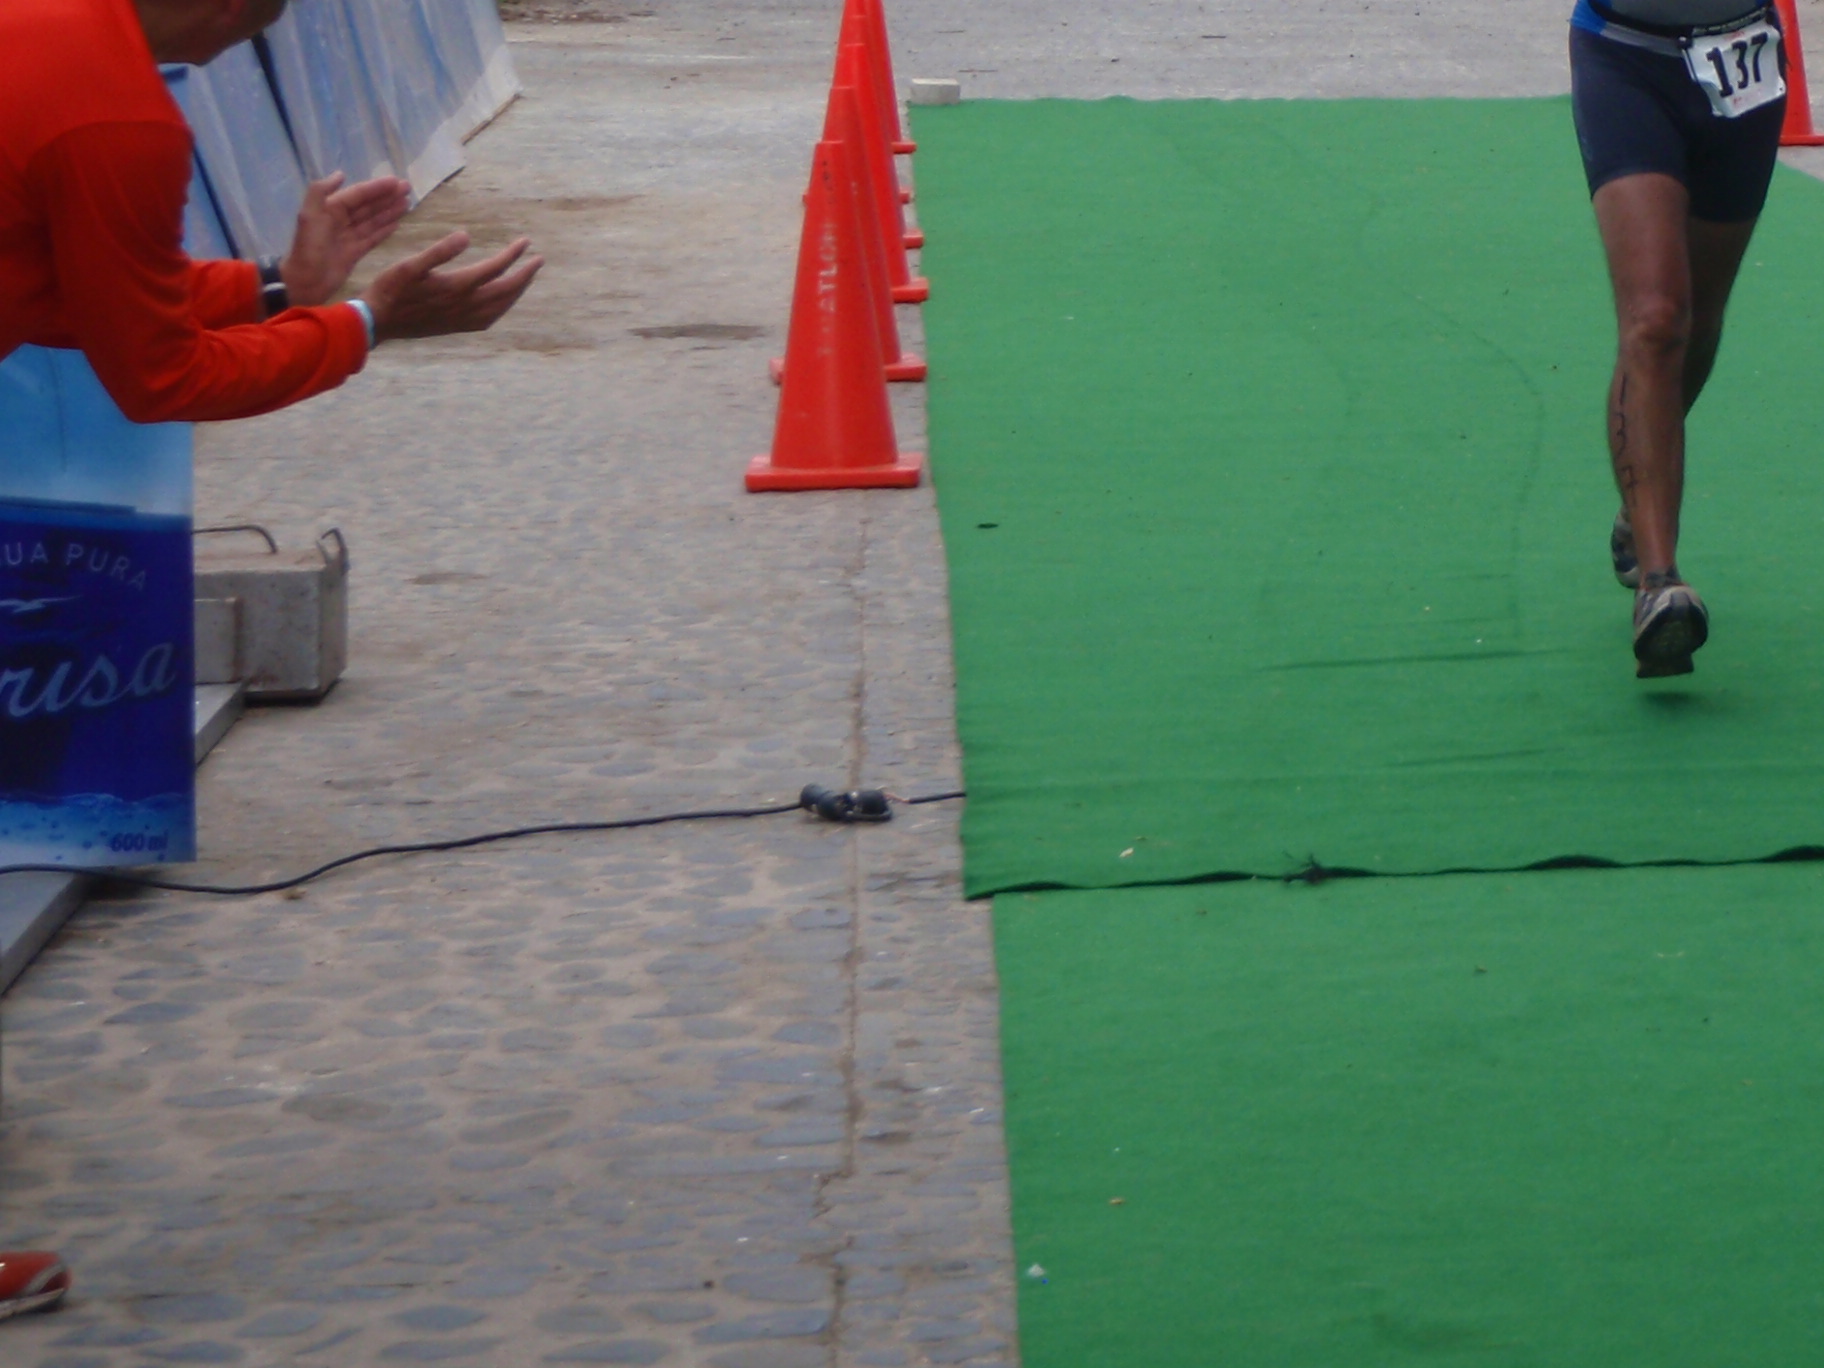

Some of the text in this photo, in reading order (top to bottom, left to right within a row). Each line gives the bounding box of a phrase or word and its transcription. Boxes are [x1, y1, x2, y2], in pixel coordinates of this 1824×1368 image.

[1706, 32, 1769, 98] 137
[0, 541, 147, 591] UA PURA
[0, 642, 177, 718] risa
[111, 833, 145, 853] 600
